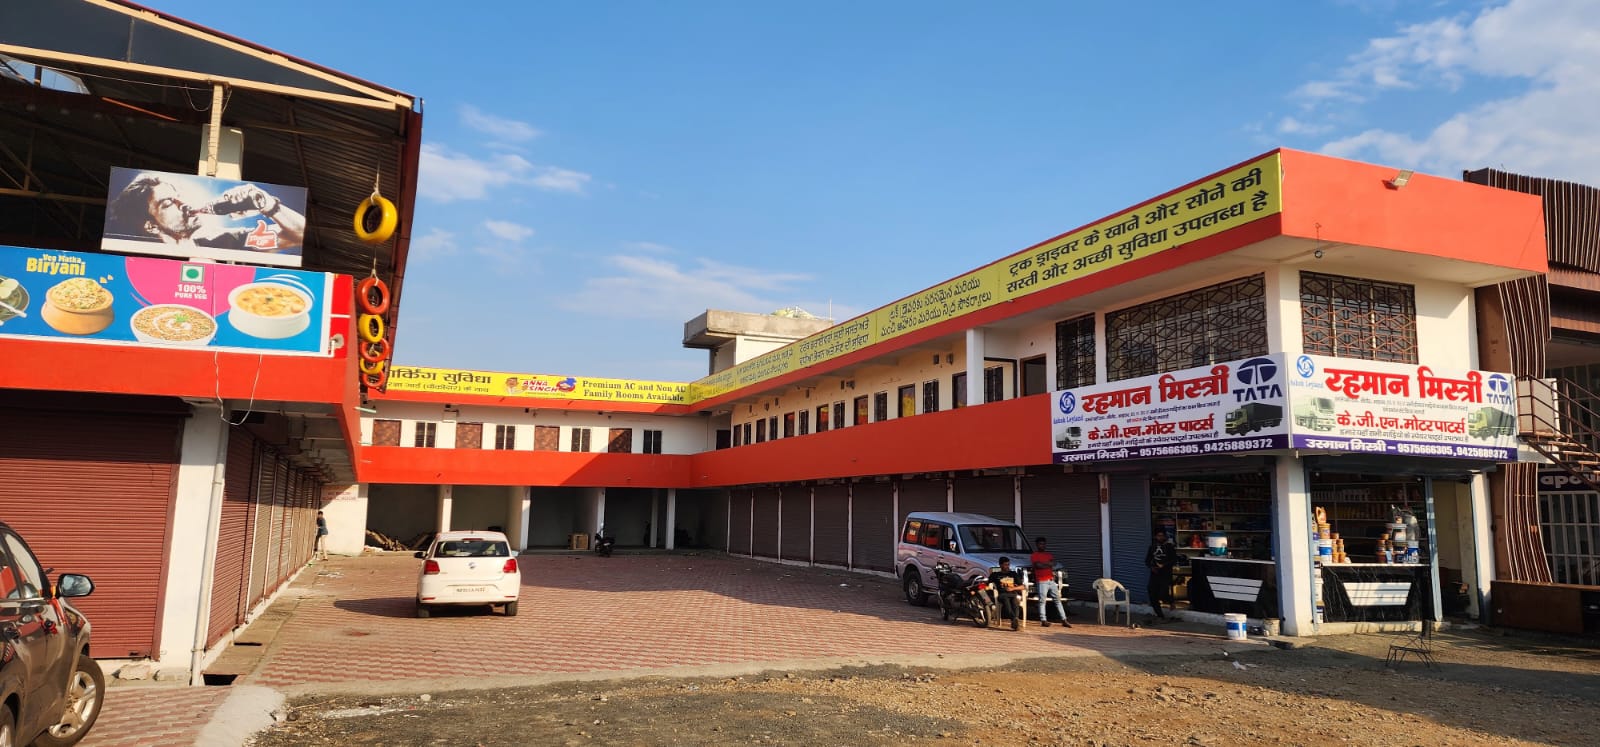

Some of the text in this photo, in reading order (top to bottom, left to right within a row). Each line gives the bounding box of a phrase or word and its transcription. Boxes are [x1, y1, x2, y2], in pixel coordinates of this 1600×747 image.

[1009, 167, 1262, 277] ट्रक ड्राइवर के खाने और सोने की
[1006, 190, 1270, 293] सस्ती और अच्छी सुविधा उपलब्ध है
[26, 257, 86, 276] Biryani
[174, 291, 192, 299] PURE
[177, 284, 206, 294] 100%
[444, 371, 491, 385] सुविधा
[527, 385, 559, 393] SINGH
[582, 380, 622, 391] Premium
[623, 382, 635, 390] AC
[638, 383, 654, 392] and
[656, 384, 671, 392] Non
[1081, 385, 1152, 414] रहमान
[1159, 364, 1231, 402] मिस्त्री
[1324, 368, 1410, 399] रहमान
[1417, 366, 1483, 404] मिस्त्री
[584, 389, 685, 402] Family Rooms Available
[1232, 384, 1283, 402] TATA
[1486, 393, 1513, 405] TATA
[1305, 438, 1350, 450] उस्मान
[1061, 452, 1096, 463] उस्मान
